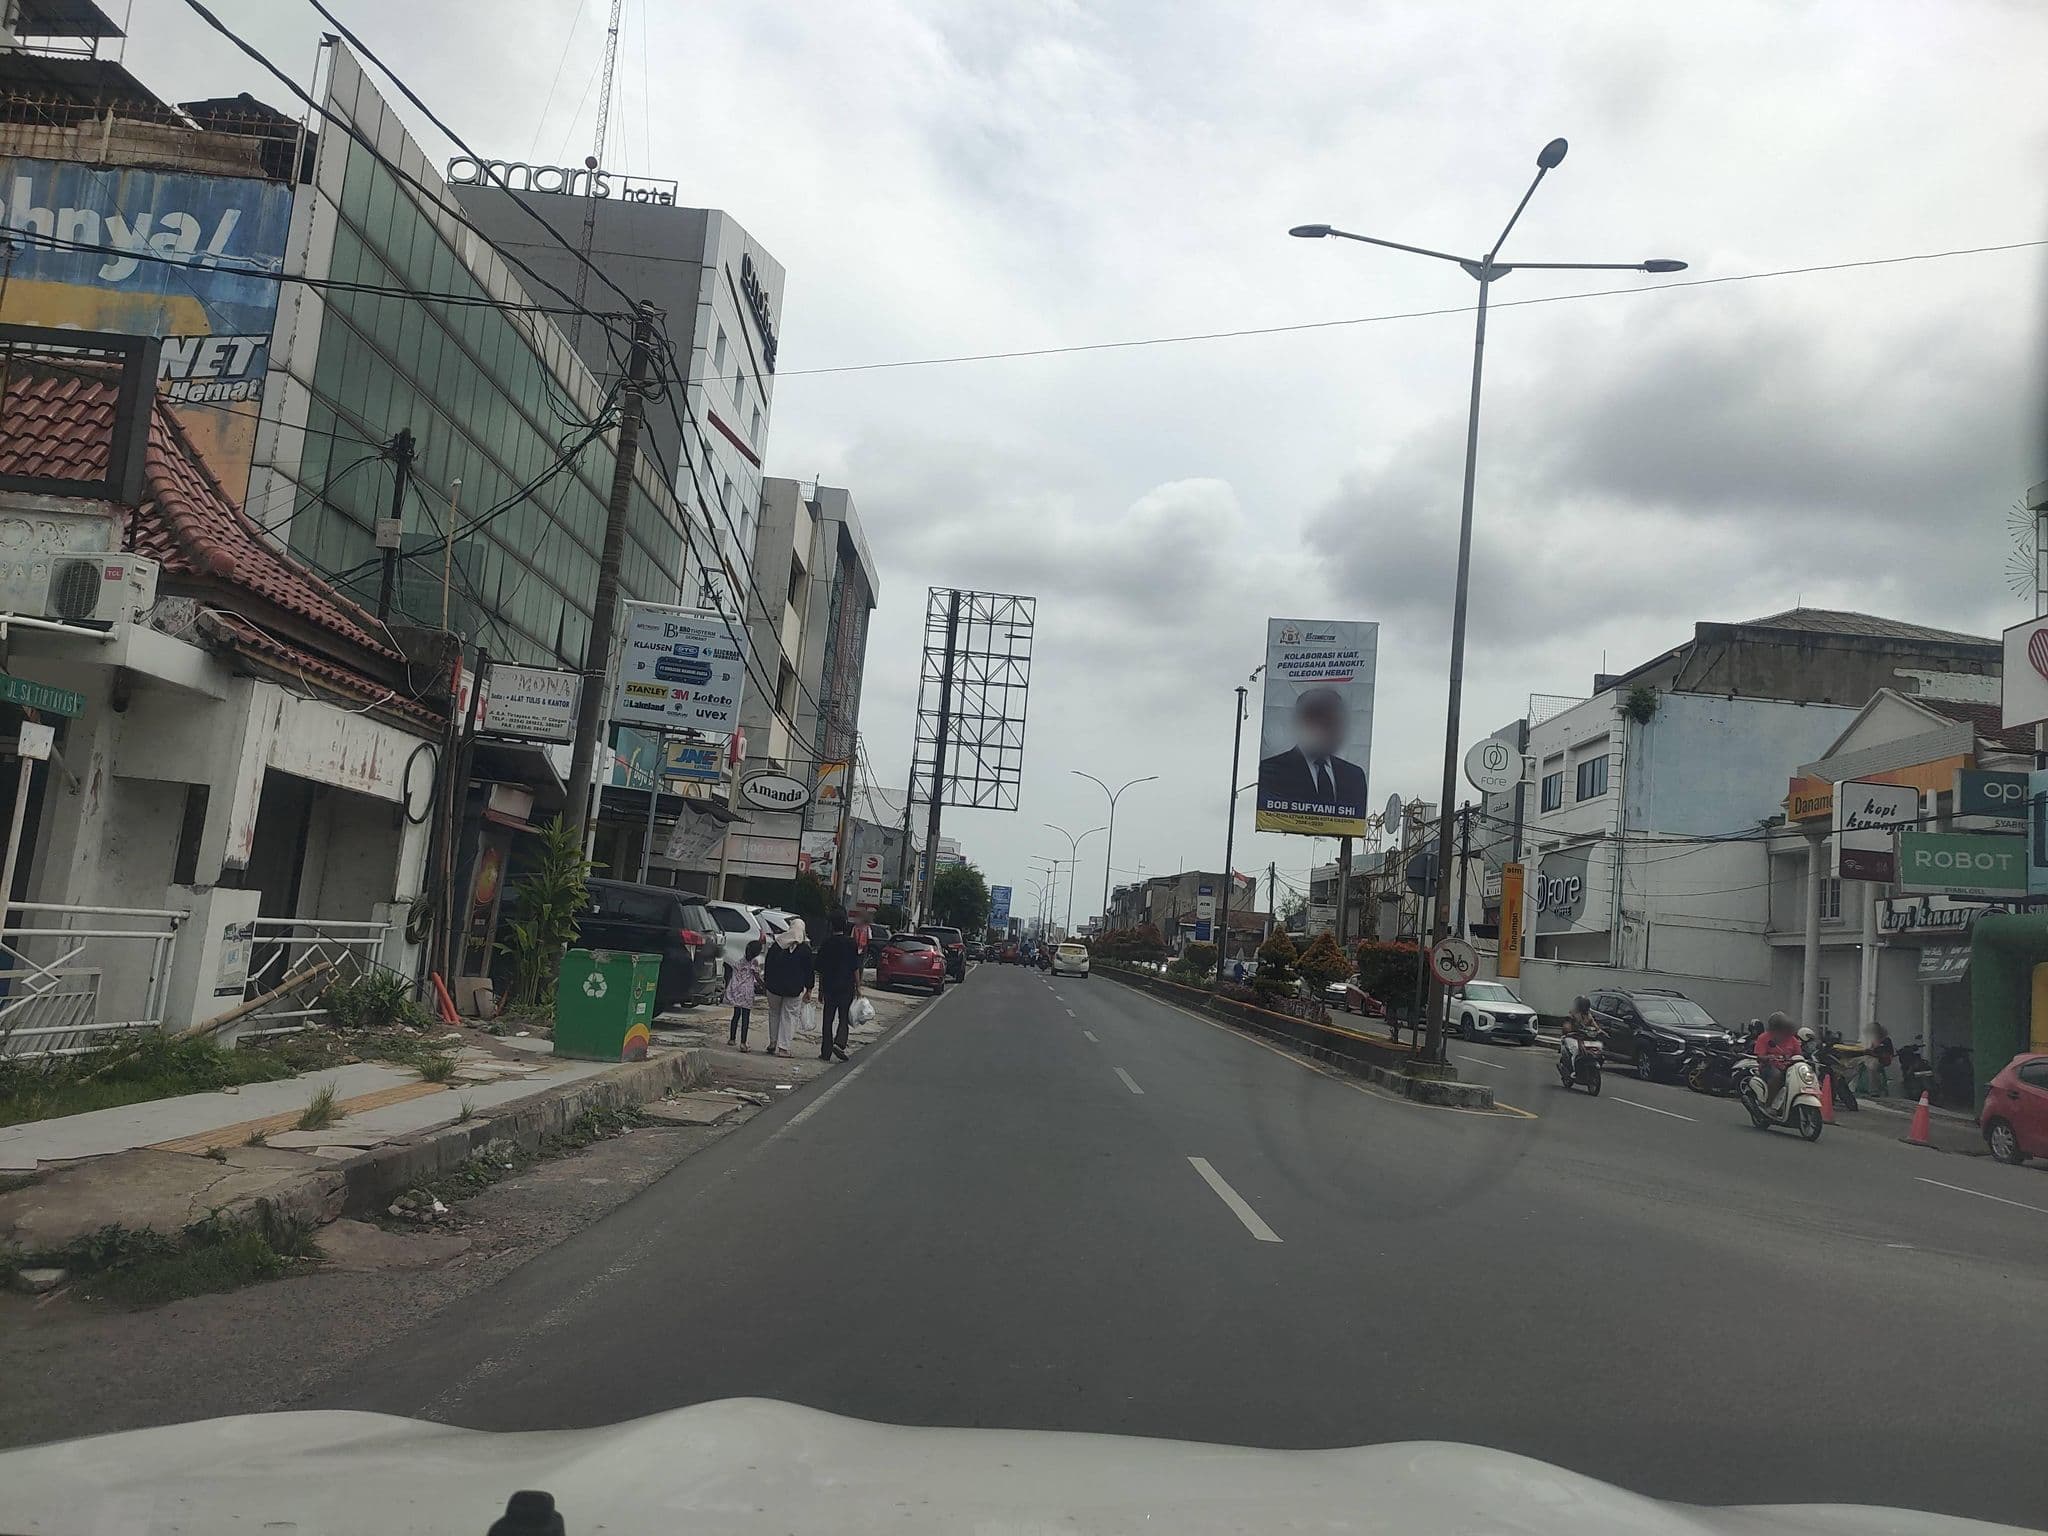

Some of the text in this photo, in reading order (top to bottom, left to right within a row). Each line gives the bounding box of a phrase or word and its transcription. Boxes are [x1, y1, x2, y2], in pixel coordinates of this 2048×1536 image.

[446, 155, 678, 206] amaris hotel
[0, 176, 242, 282] hnya!
[633, 640, 673, 652] KLAUSEN
[1284, 651, 1360, 660] KOLABORASI KUAT,
[1277, 660, 1365, 669] PENGUSAHA BANGKIT,
[1325, 669, 1354, 677] HEBAT!
[626, 684, 667, 696] STANLEY
[670, 688, 689, 701] 3M
[547, 699, 570, 708] KANTOR
[629, 700, 665, 712] Lakeland
[696, 708, 728, 720] uvex
[671, 748, 719, 766] JNE
[747, 781, 802, 802] Amanda
[1266, 800, 1288, 809] BOB
[1291, 802, 1336, 814] SUFYANI
[1863, 798, 1898, 819] kopi
[1914, 850, 2013, 871] ROBOT
[1507, 866, 1523, 874] atm
[862, 886, 879, 895] atm
[1510, 912, 1519, 952] Danamon
